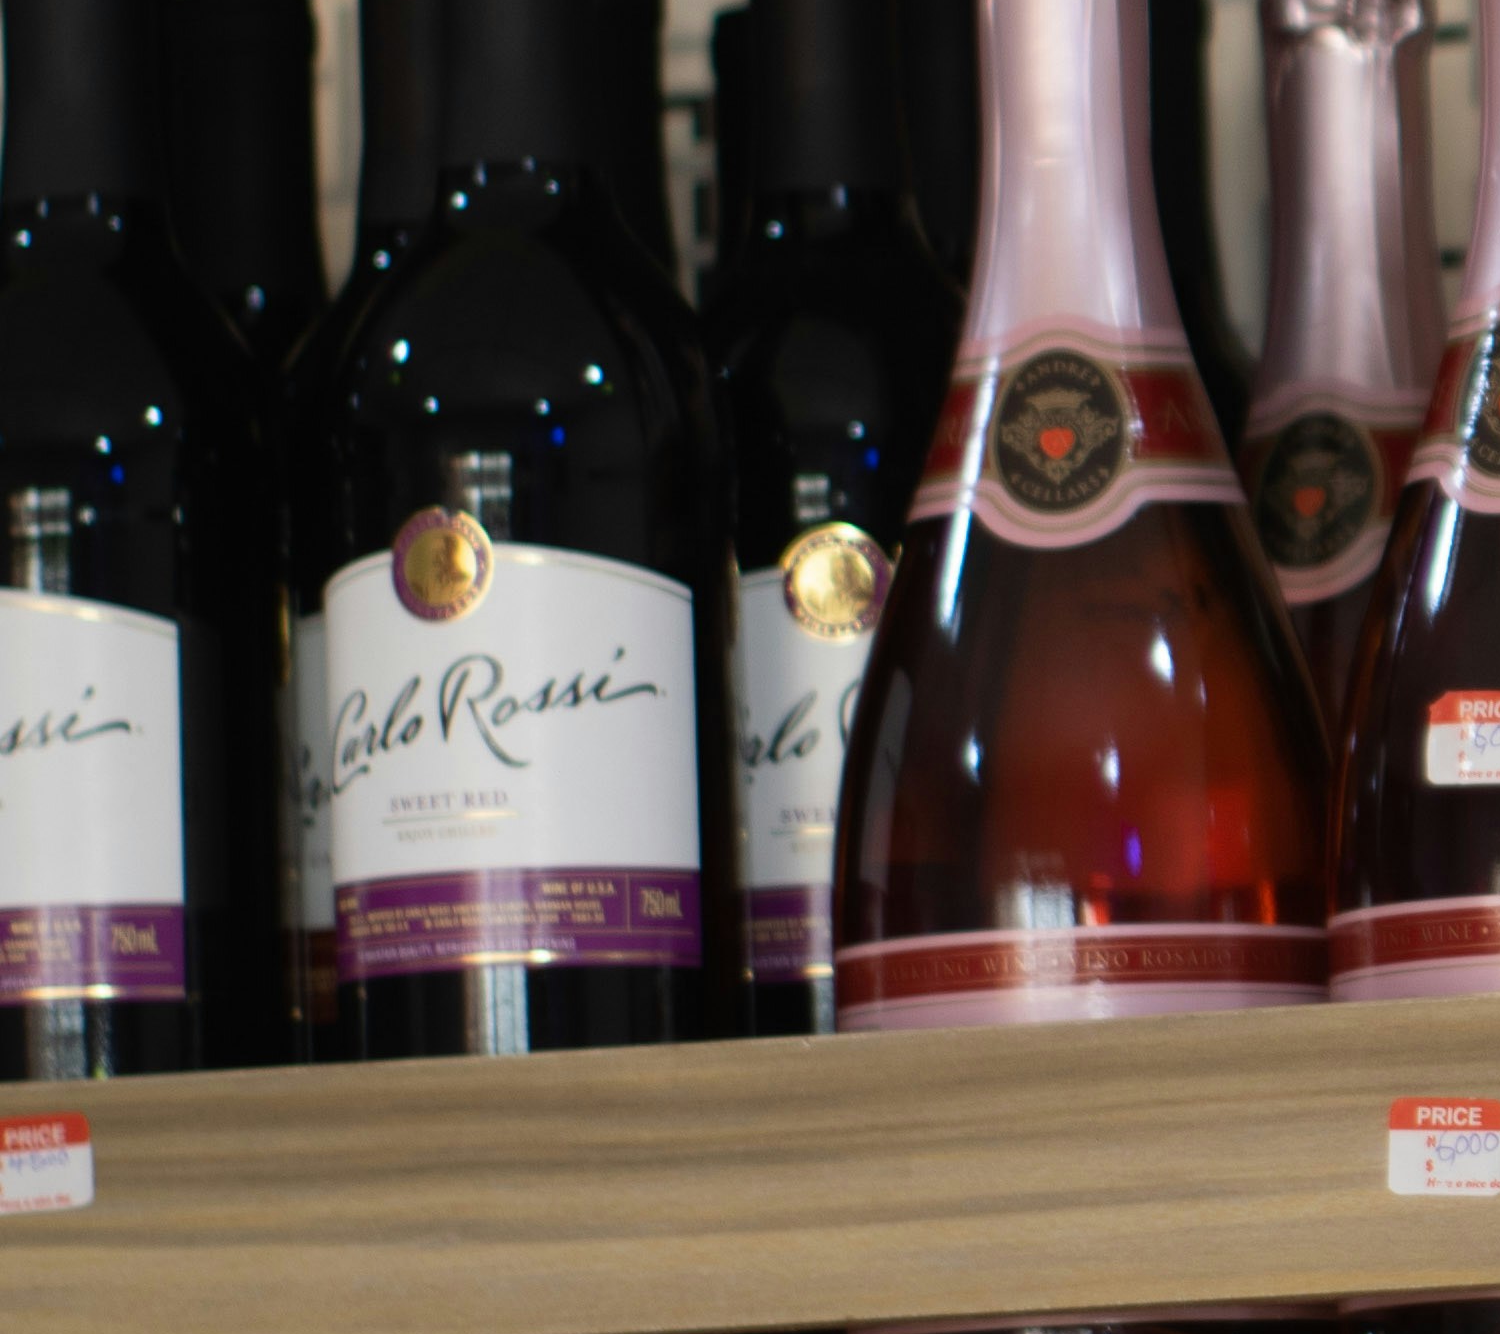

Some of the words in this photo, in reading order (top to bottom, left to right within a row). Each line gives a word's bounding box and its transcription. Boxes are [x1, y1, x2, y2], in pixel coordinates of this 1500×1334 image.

[331, 675, 425, 797] Carlo
[440, 647, 660, 768] Rossi
[389, 792, 453, 814] SWEET
[462, 789, 508, 809] RED
[641, 886, 684, 919] 750mL
[1069, 949, 1129, 969] VINO
[1141, 948, 1233, 968] ROSADO
[1416, 1106, 1483, 1126] PRICE
[4, 1122, 67, 1146] PRICE
